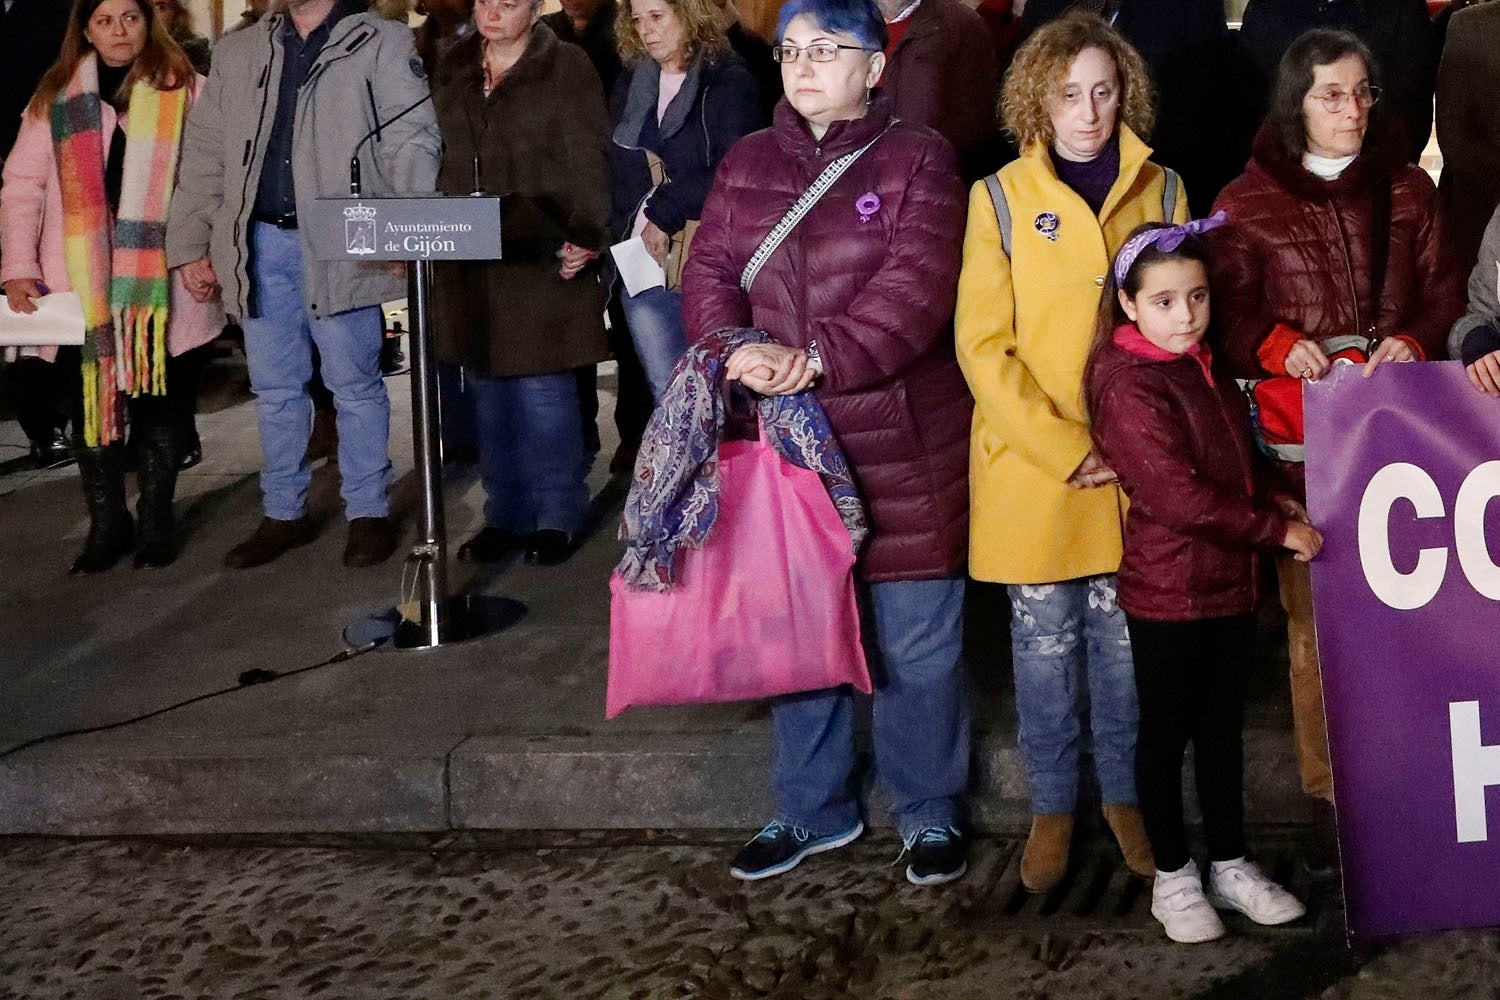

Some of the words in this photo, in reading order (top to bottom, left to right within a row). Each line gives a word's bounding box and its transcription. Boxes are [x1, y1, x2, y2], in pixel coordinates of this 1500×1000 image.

[385, 221, 472, 236] Ayuntamiento
[384, 240, 400, 252] de
[403, 235, 457, 257] Gijón
